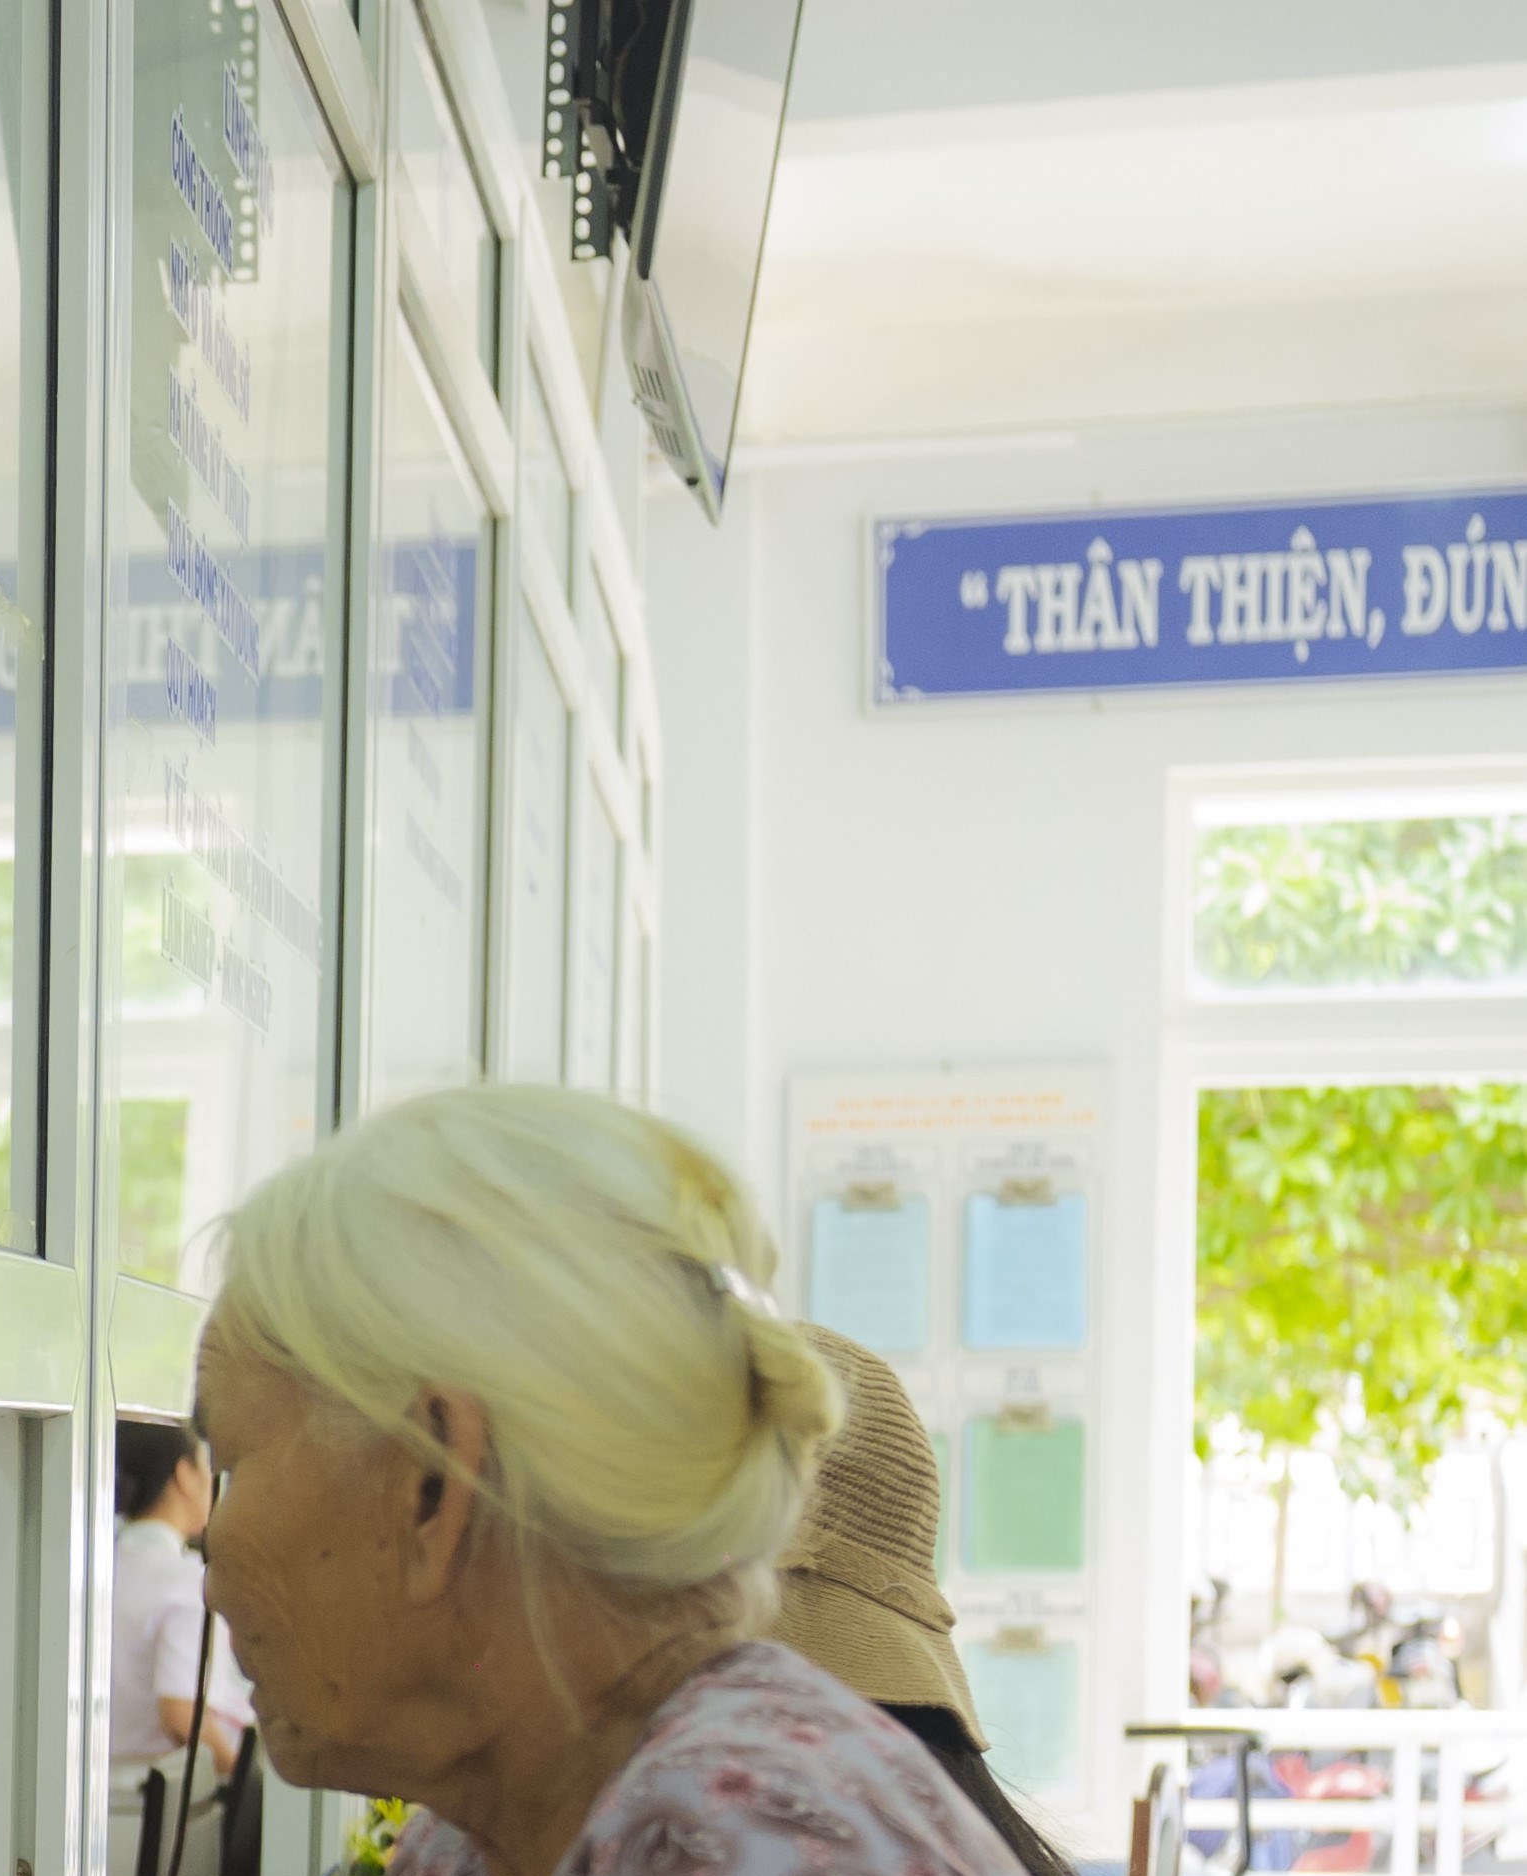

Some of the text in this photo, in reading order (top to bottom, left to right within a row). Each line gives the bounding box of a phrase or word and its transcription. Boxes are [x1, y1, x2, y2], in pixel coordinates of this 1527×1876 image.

[223, 63, 249, 183] LĨNH
[171, 109, 232, 275] CÔNG THƯƠNG
[170, 240, 189, 331] NHÀ
[215, 304, 237, 406] CÔNG
[168, 502, 193, 597] HOẠT
[195, 532, 217, 624] ĐỘNG
[1178, 524, 1387, 664] THIỆN,
[166, 637, 217, 748] QUY HOẠCH
